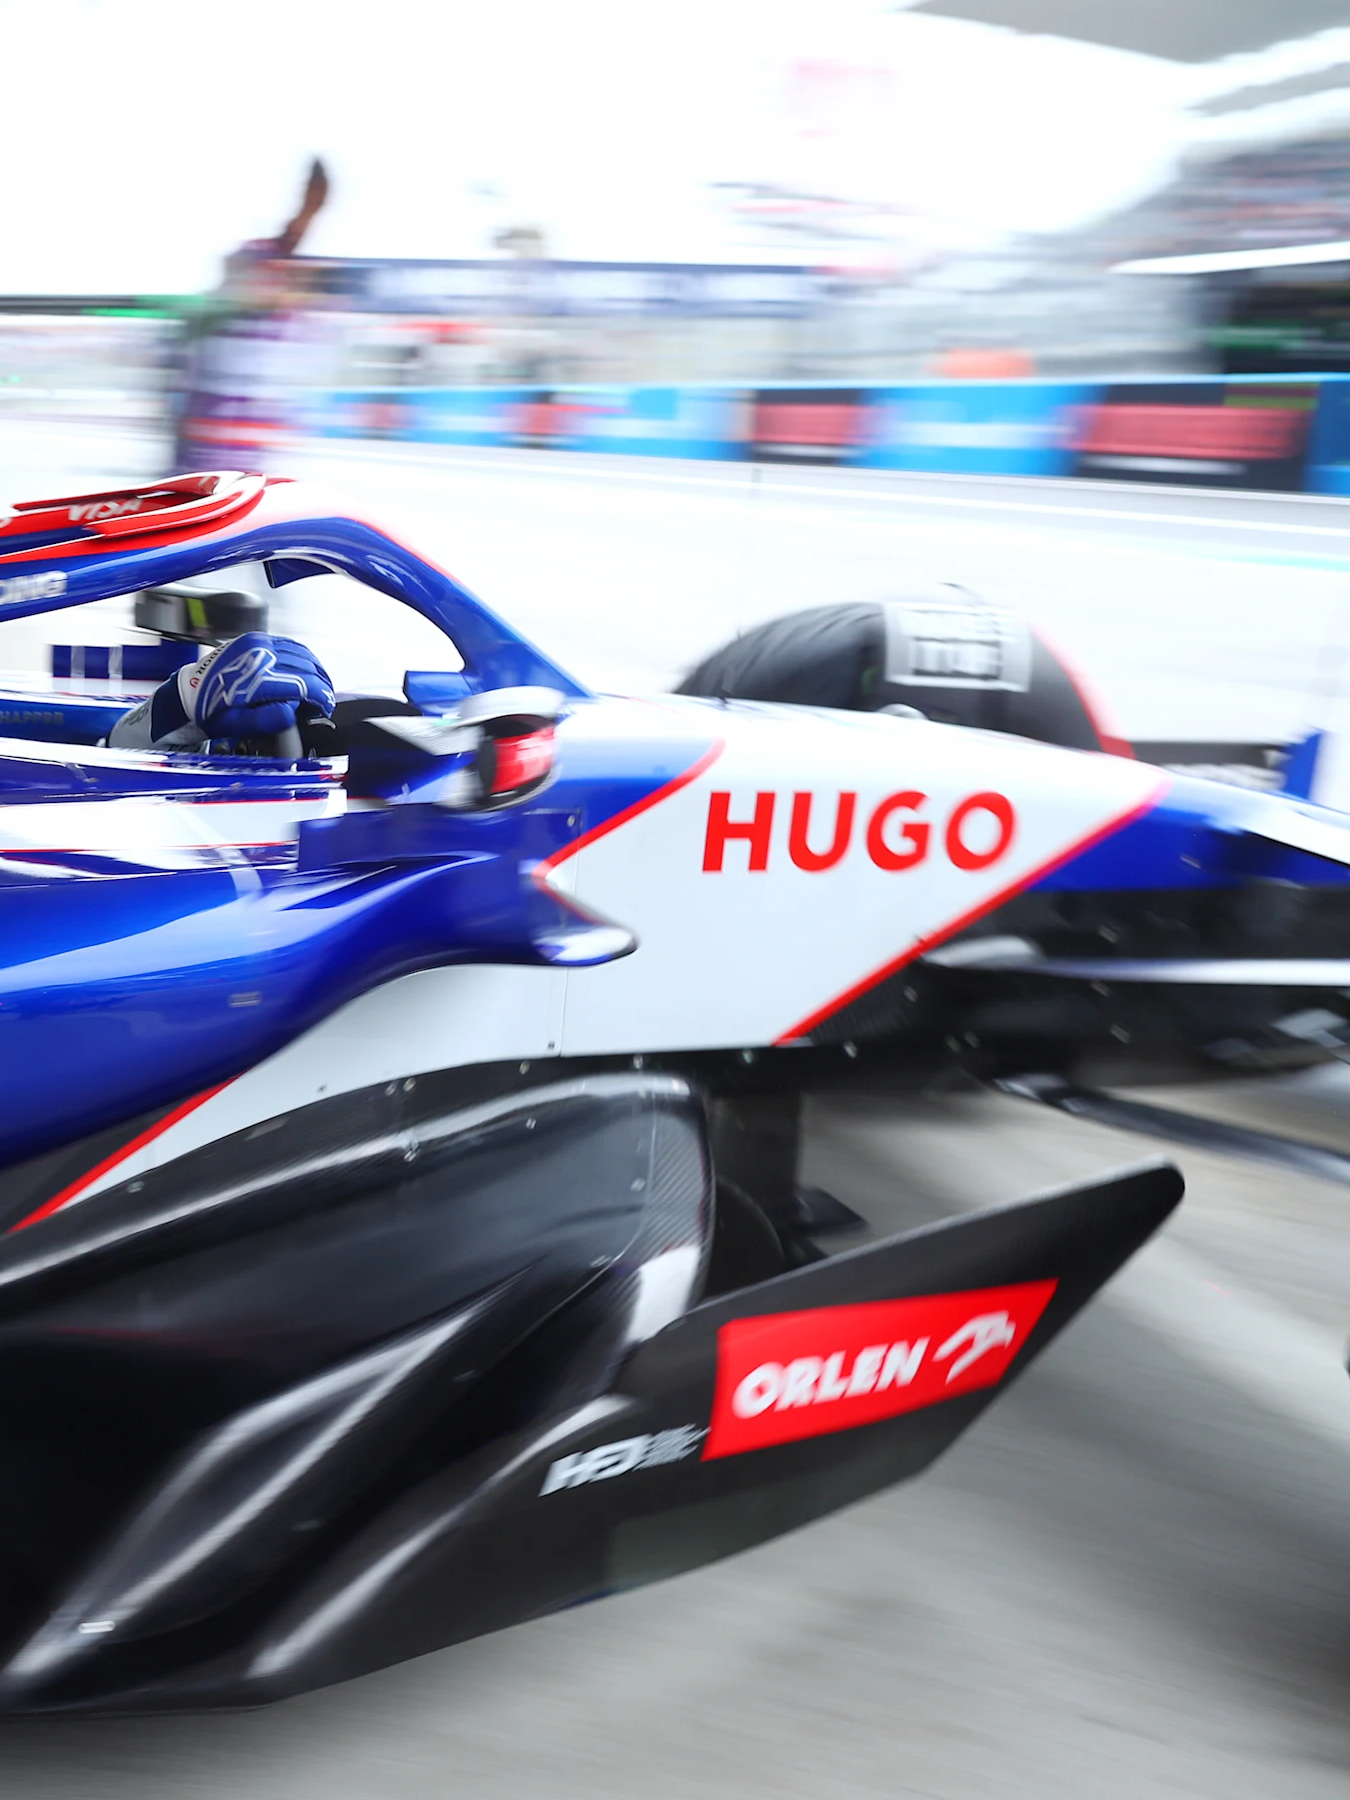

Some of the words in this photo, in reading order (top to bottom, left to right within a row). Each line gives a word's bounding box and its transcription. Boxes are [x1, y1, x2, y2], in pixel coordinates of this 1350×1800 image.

[68, 498, 143, 521] VISA
[702, 790, 1017, 873] HUGO
[732, 1336, 931, 1419] ORLEN
